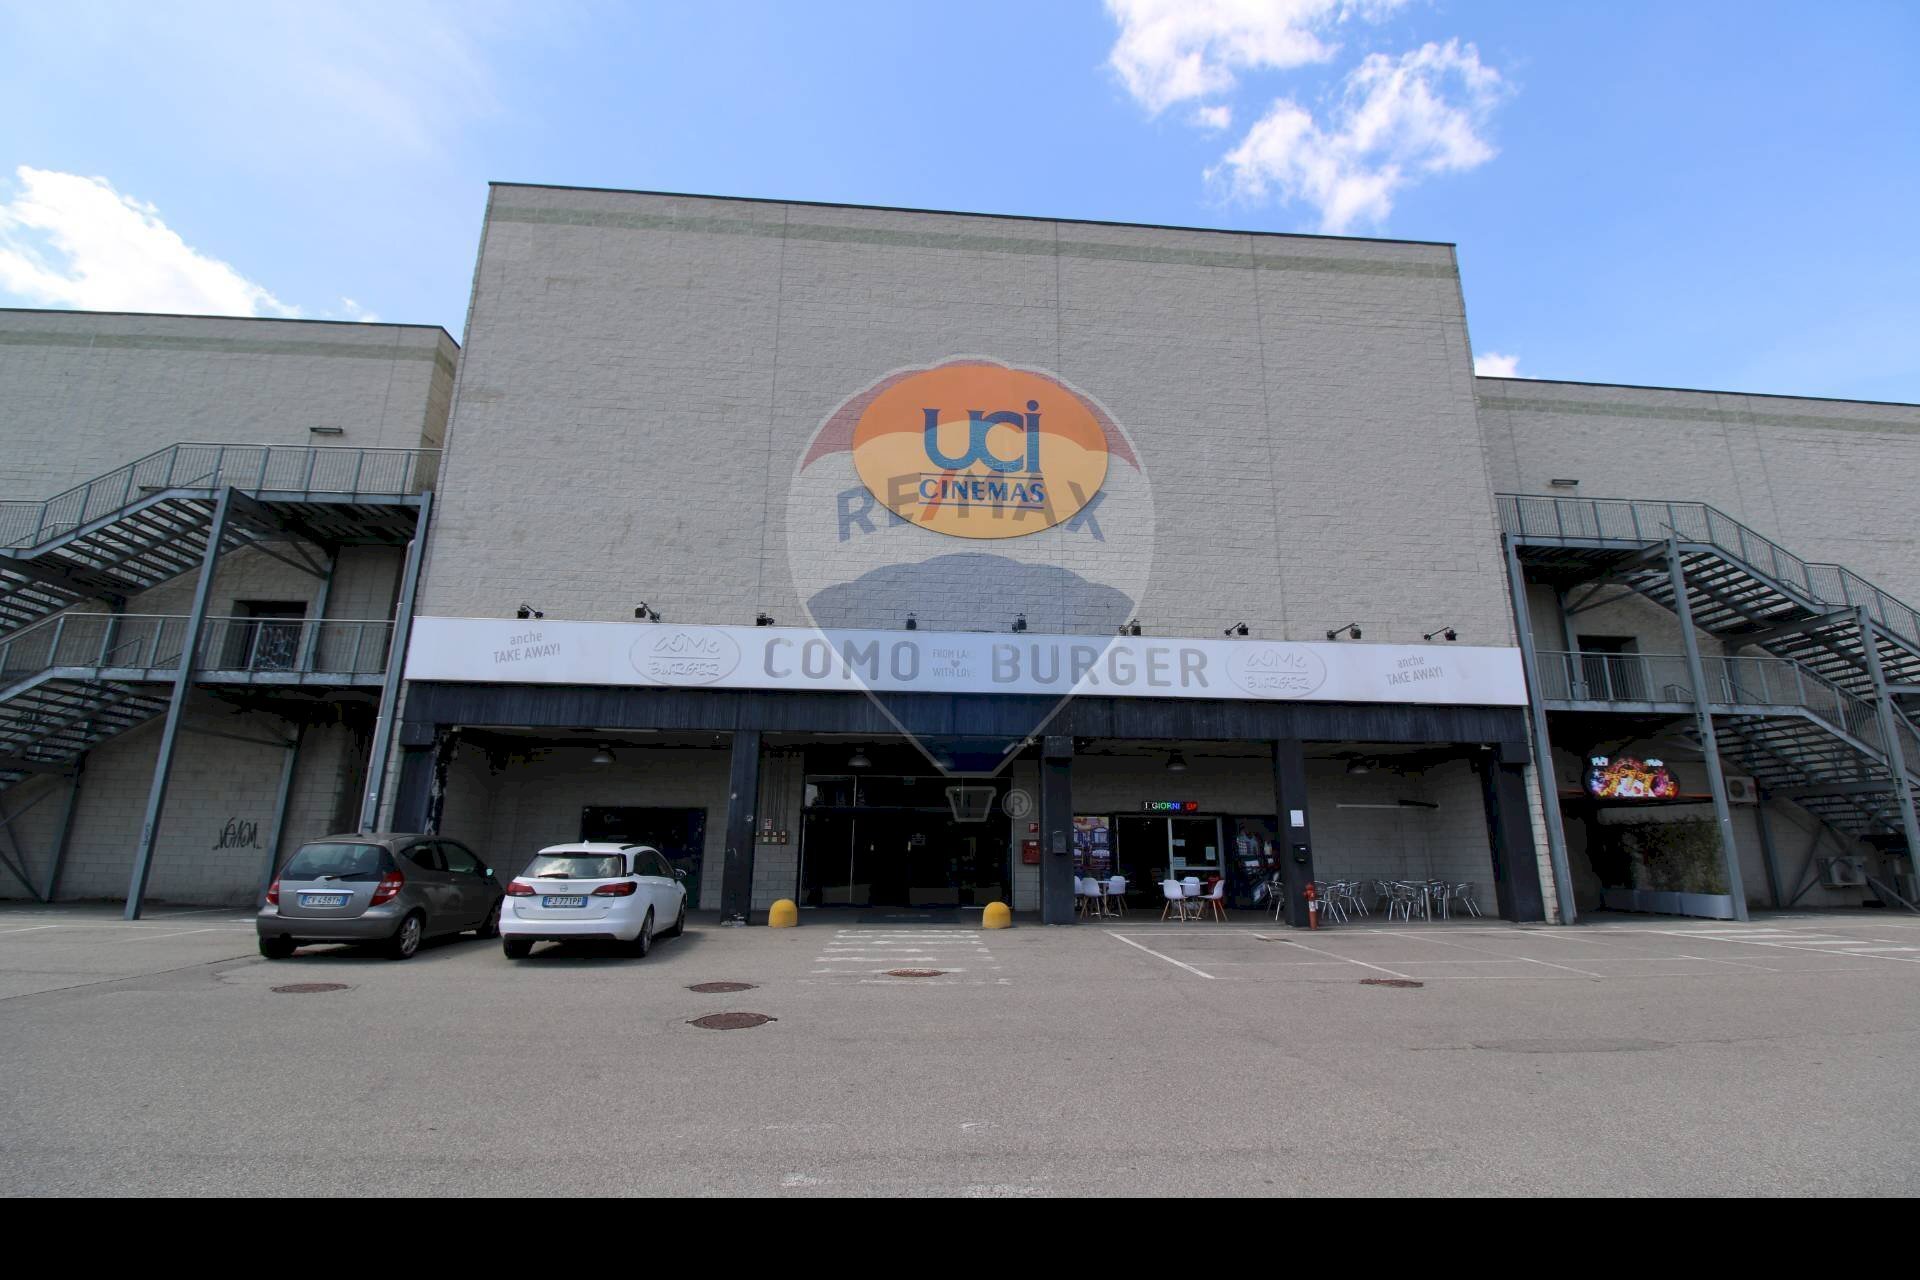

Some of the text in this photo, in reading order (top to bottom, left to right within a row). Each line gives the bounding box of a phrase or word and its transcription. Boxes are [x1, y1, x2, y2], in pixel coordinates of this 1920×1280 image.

[919, 478, 1045, 503] CINEMAS
[510, 630, 543, 645] anche
[493, 643, 561, 664] TAKE AWAY!
[932, 648, 954, 658] FROM
[764, 637, 1209, 688] COMO BURGER
[1398, 655, 1424, 668] anche
[932, 667, 955, 678] WITH
[1385, 665, 1444, 685] TAKE AWAY!
[1151, 802, 1180, 810] GIORNI
